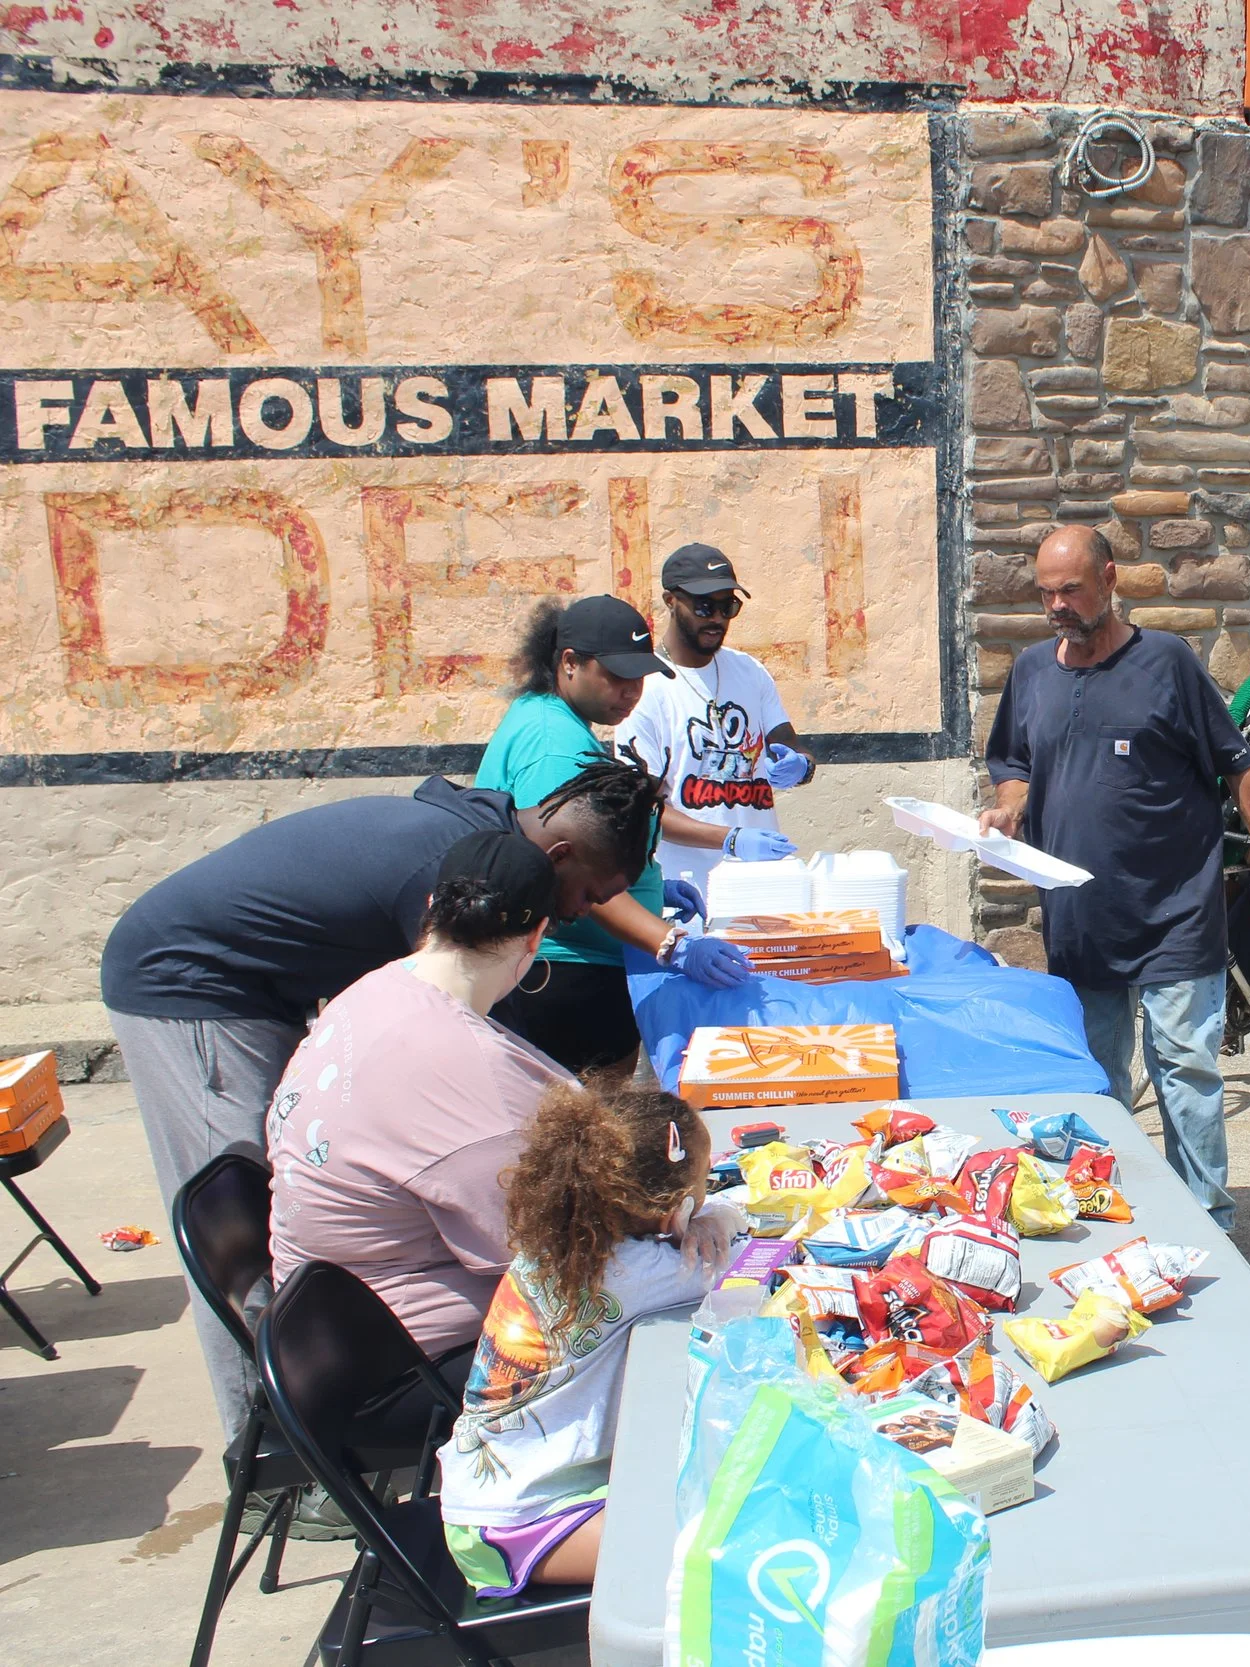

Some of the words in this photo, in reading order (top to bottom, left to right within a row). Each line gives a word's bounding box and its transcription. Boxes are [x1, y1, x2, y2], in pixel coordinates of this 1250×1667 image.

[13, 376, 455, 452] FAMOUS
[486, 371, 895, 446] MARKET
[45, 475, 868, 708] DELI
[687, 701, 748, 760] NO
[712, 1091, 755, 1101] SUMMER
[756, 1089, 797, 1100] CHILLIN'
[1079, 1188, 1113, 1214] Chee
[814, 1494, 826, 1535] done
[824, 1494, 839, 1547] simply
